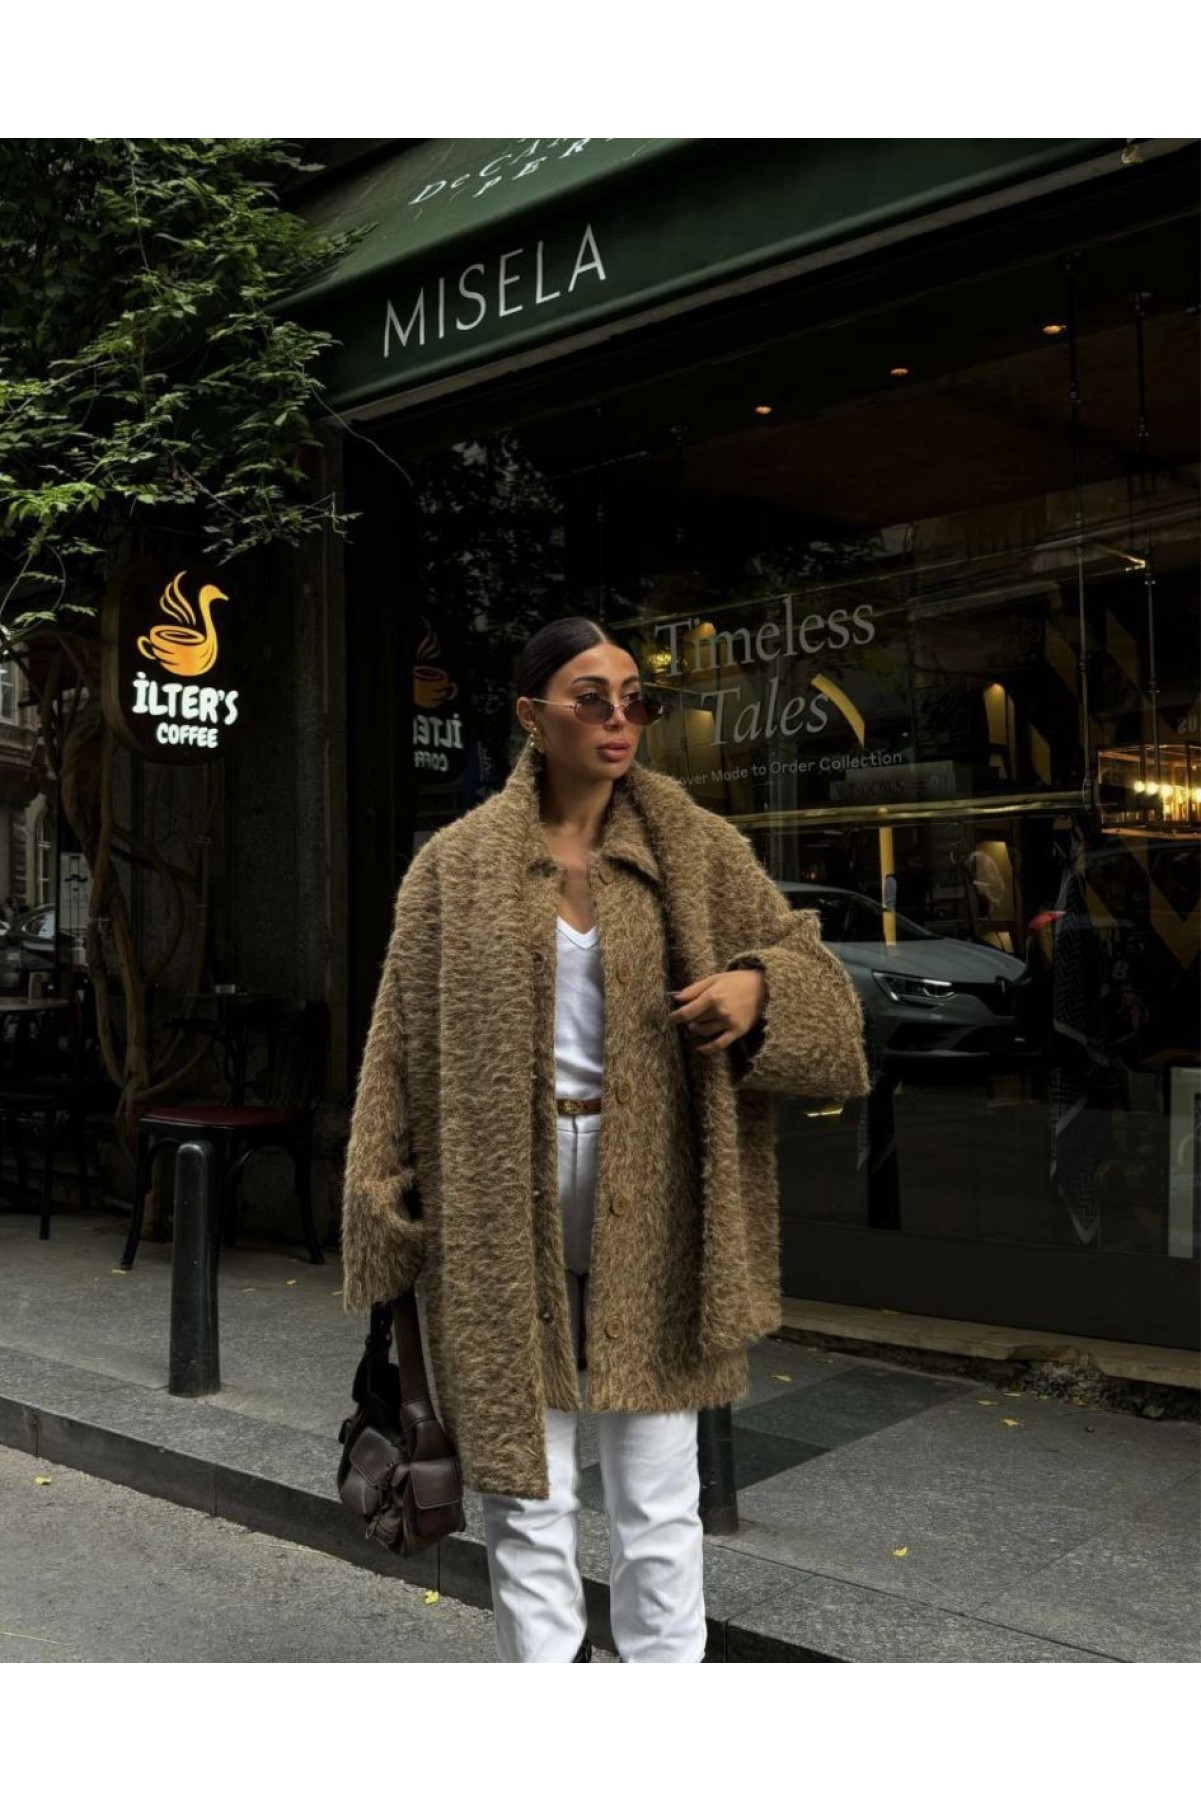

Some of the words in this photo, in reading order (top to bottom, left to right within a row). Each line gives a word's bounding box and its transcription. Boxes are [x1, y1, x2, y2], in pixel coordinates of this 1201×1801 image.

[384, 223, 606, 358] MISELA
[654, 595, 875, 678] Timeless
[132, 671, 239, 726] İLTER'S
[701, 676, 830, 746] Tales
[156, 722, 219, 749] COFFEE
[710, 765, 749, 783] Made
[751, 763, 767, 777] to
[769, 758, 816, 775] Order
[819, 748, 902, 772] Collection
